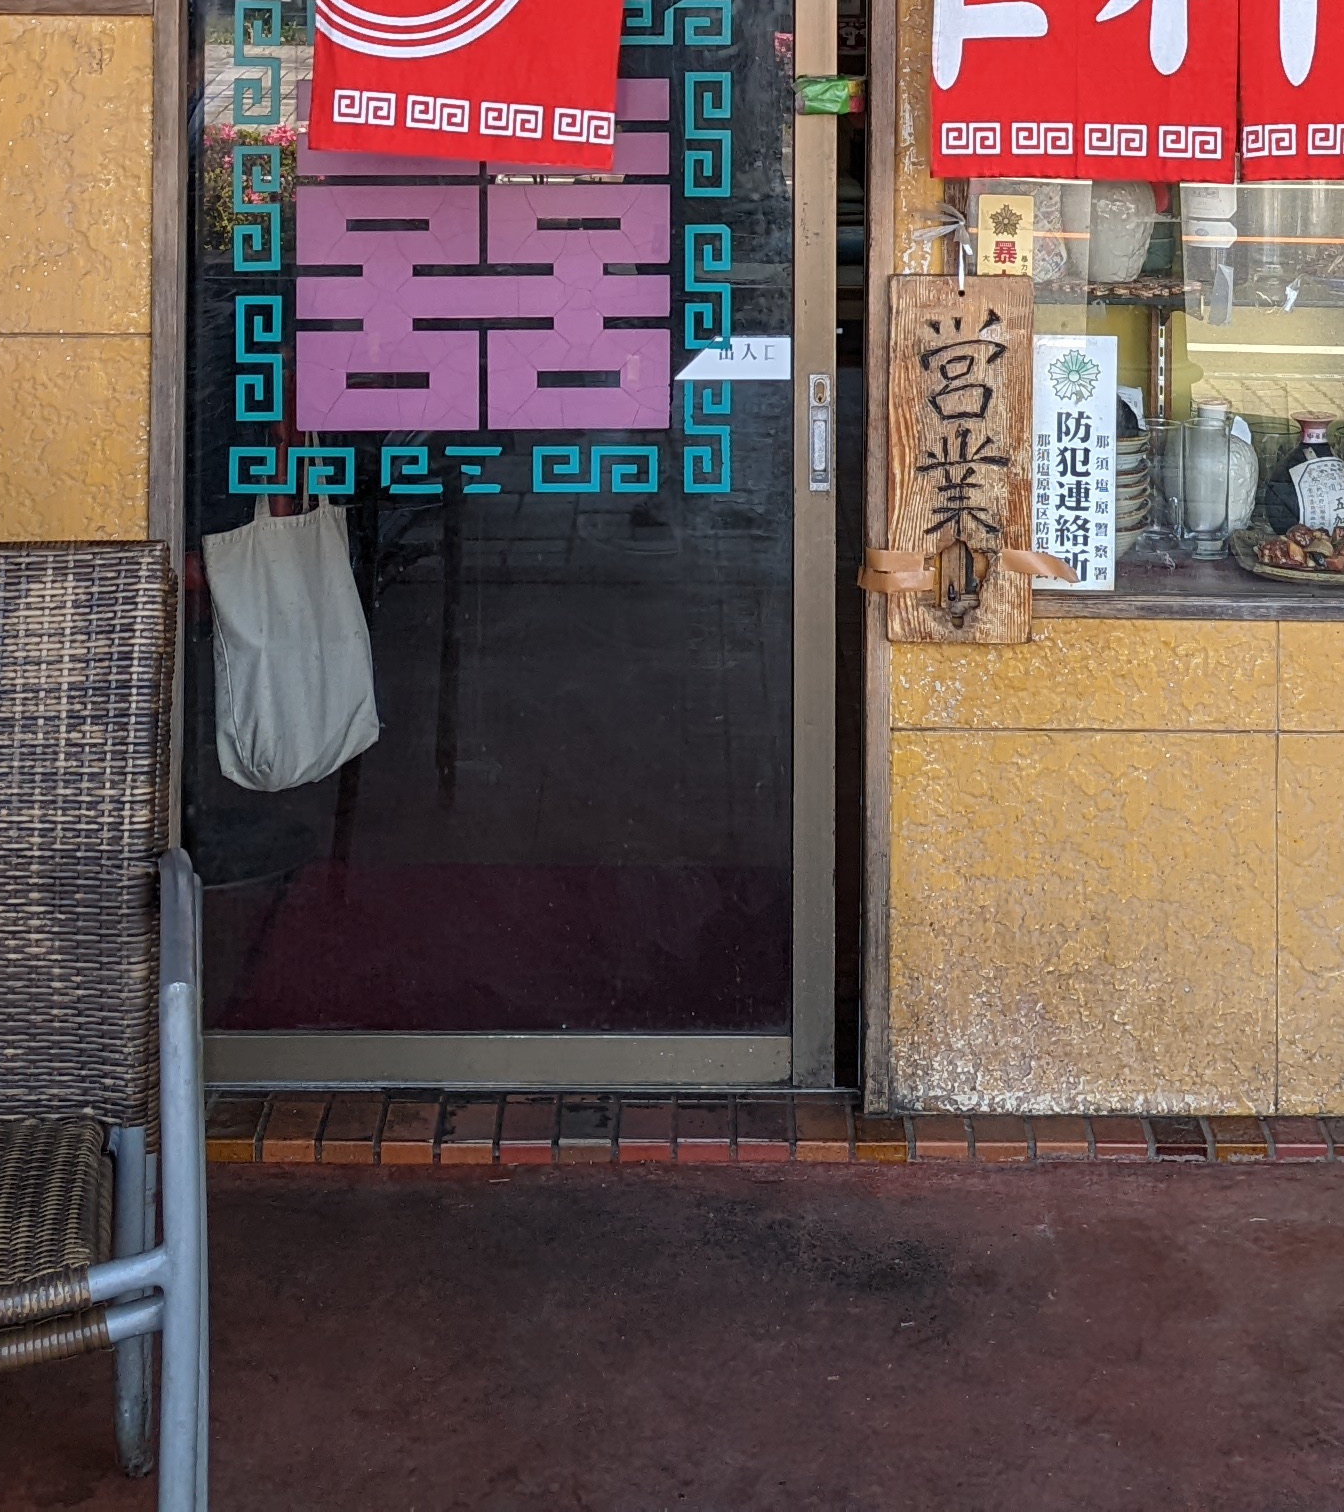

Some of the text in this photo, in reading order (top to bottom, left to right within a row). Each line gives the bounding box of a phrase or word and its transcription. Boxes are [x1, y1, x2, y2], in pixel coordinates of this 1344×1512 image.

[1036, 434, 1051, 579] 那須塩原地区防犯
[1094, 435, 1110, 581] 那須塩原警察署
